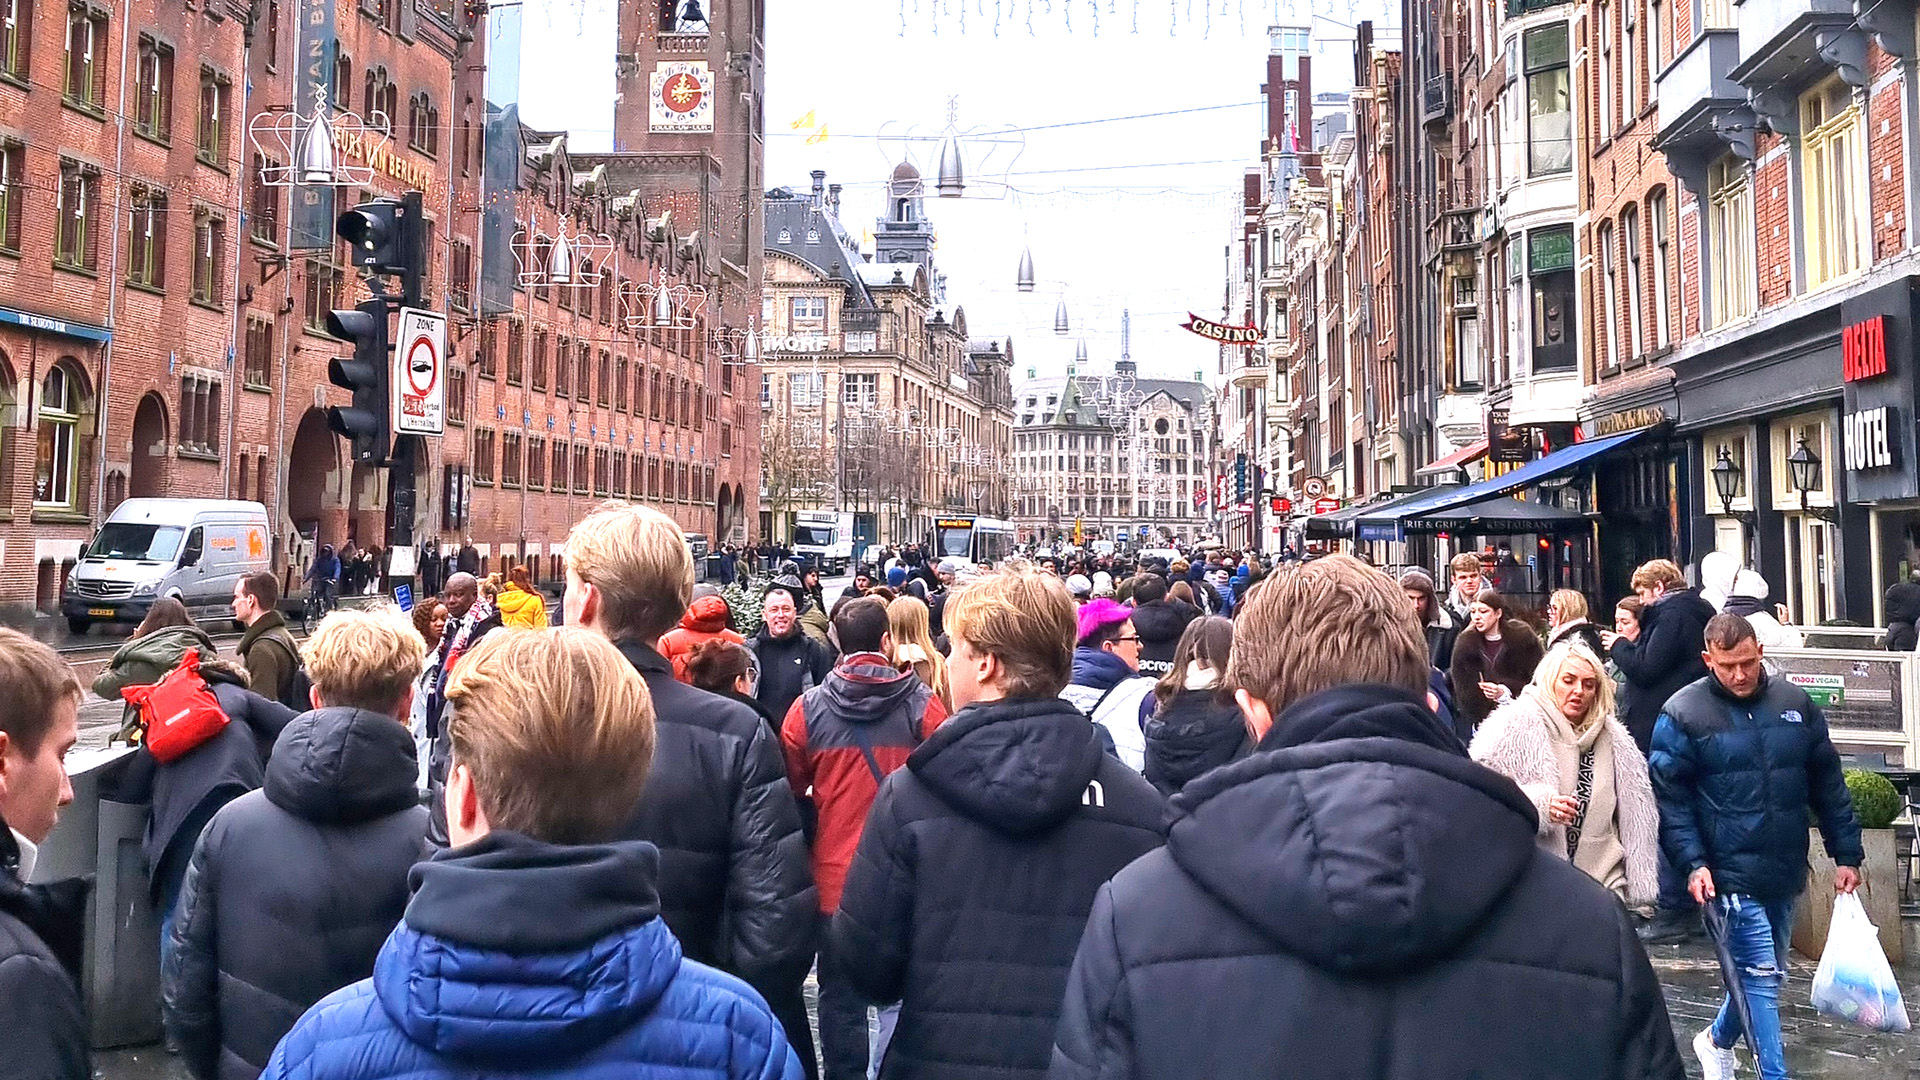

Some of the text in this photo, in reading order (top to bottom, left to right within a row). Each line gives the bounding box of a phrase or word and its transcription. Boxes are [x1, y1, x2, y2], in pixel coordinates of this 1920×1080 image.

[333, 125, 362, 159] EURS
[388, 152, 431, 191] BERLAGE
[416, 318, 435, 332] ZONE
[1192, 320, 1259, 342] CASINO
[1842, 315, 1887, 383] DELTA
[1843, 406, 1891, 471] HOTEL
[1486, 519, 1555, 530] RESTAURANT
